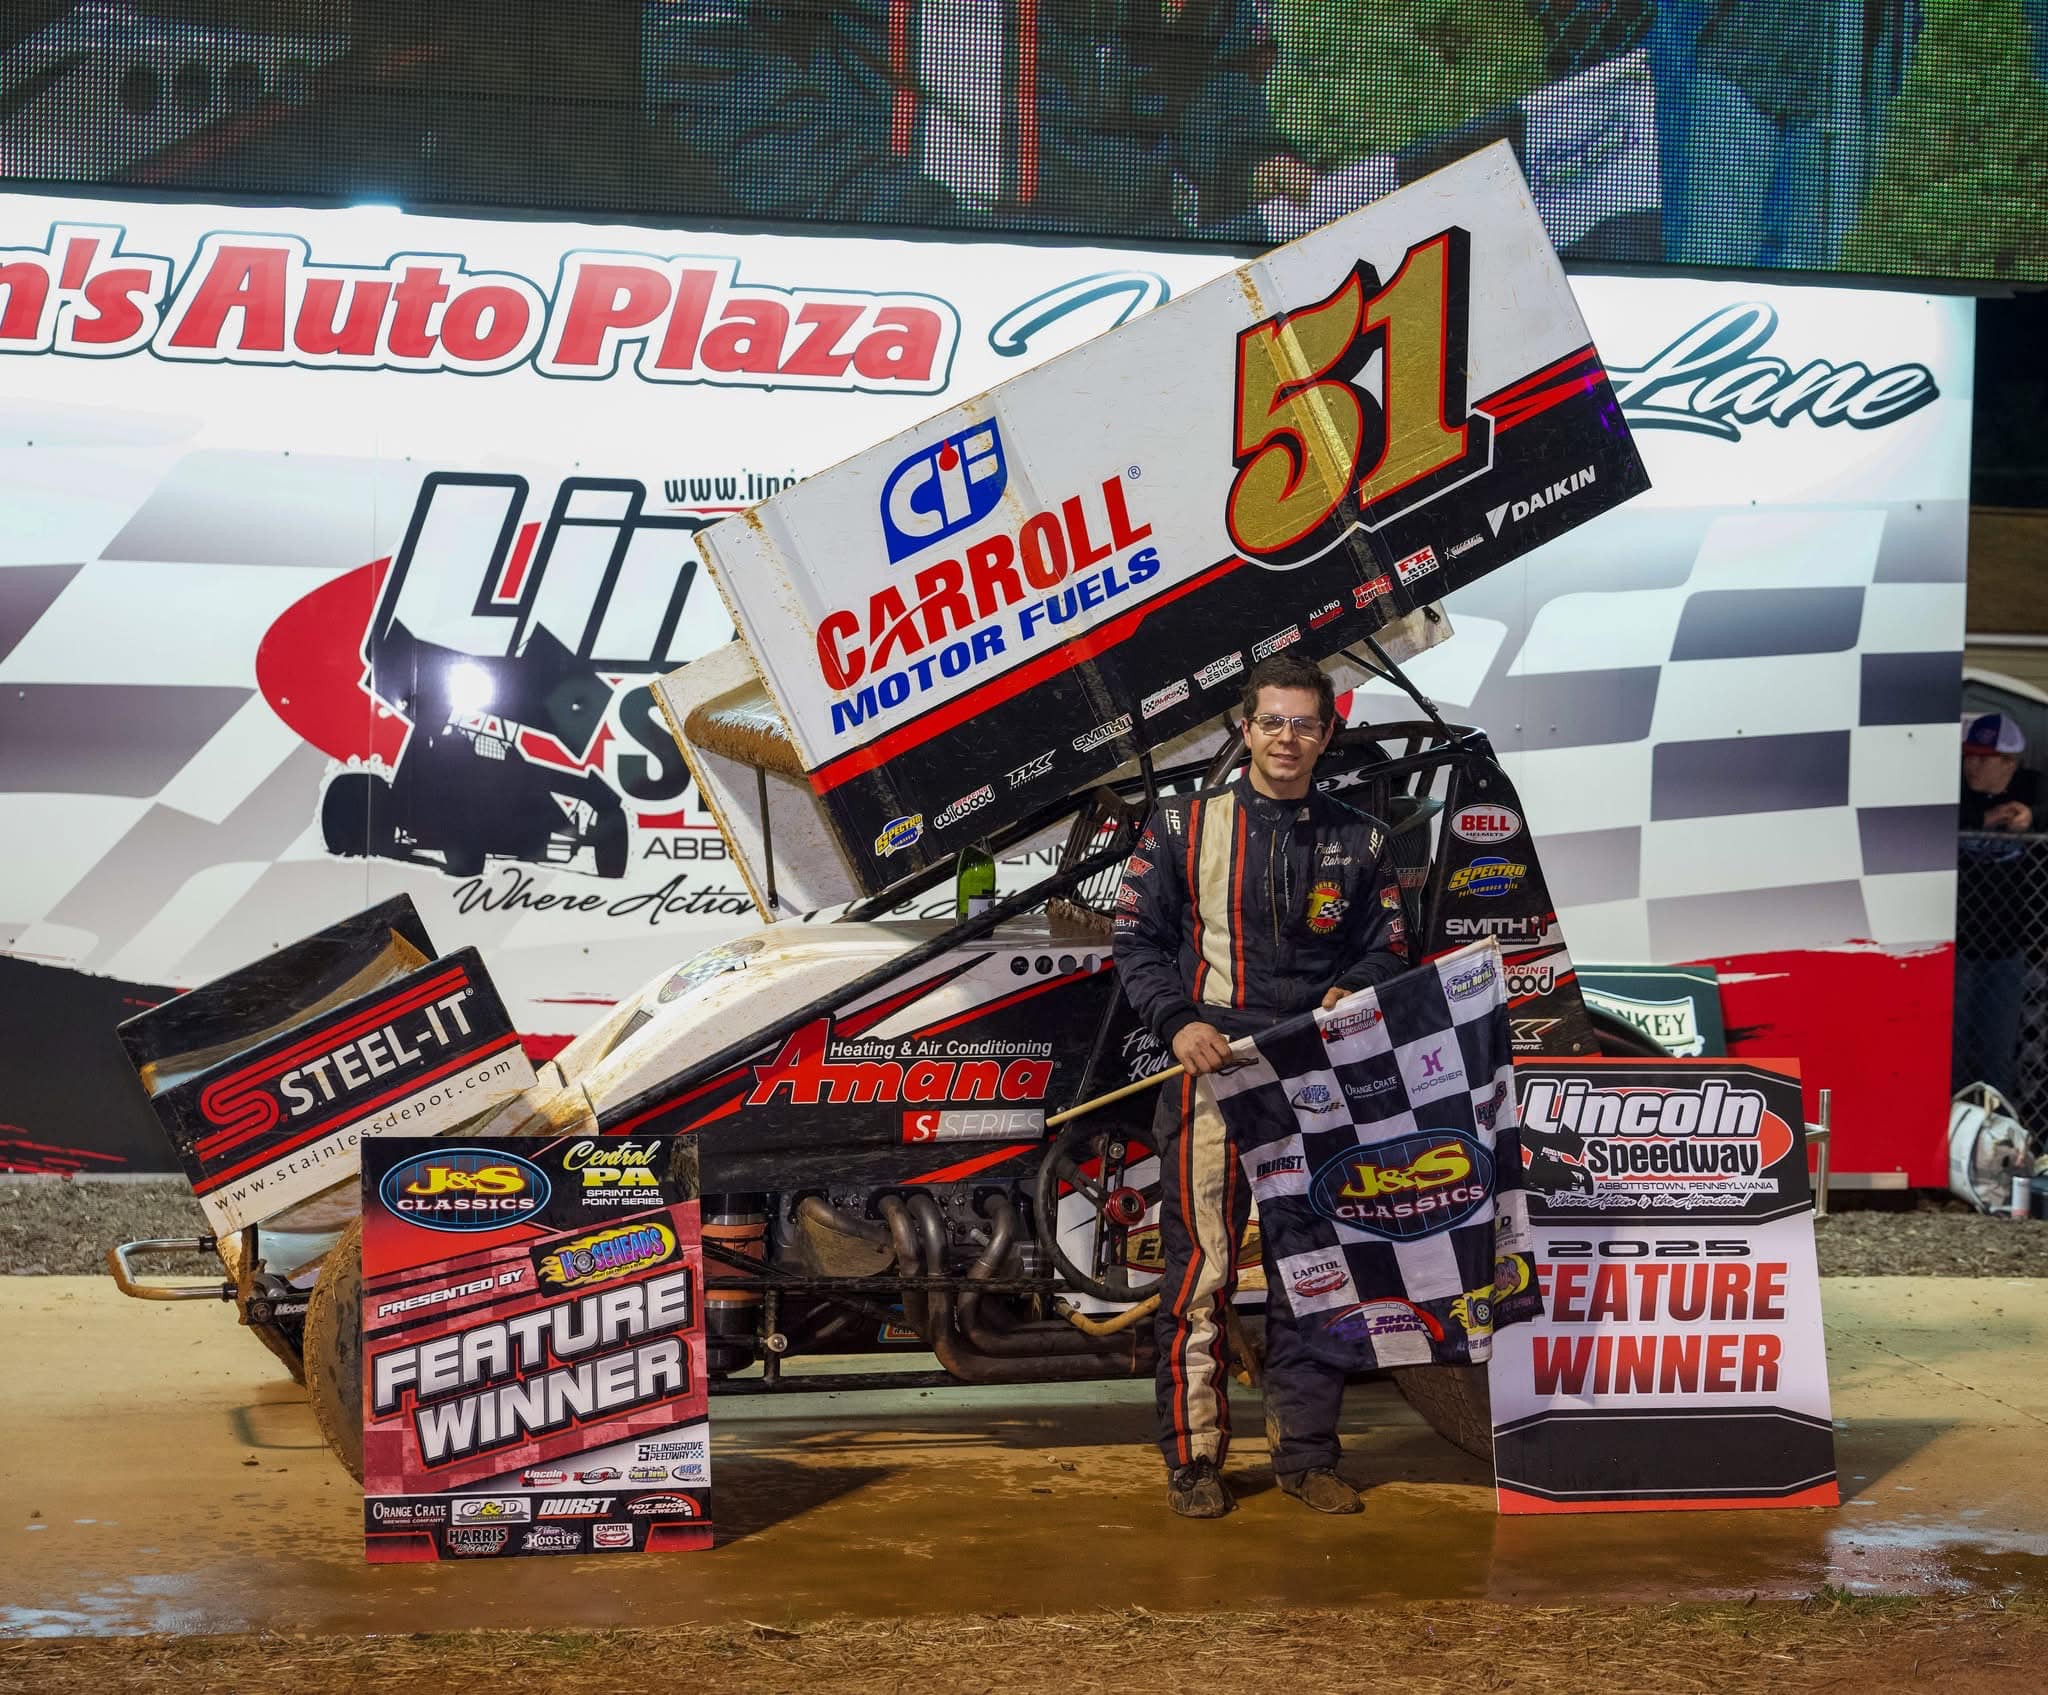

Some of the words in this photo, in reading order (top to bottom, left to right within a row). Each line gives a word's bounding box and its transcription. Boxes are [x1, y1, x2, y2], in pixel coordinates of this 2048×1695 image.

[168, 246, 530, 360] Auto
[552, 262, 942, 382] Plaza
[1604, 300, 1940, 442] Lane
[1226, 226, 1471, 560] 51
[1511, 465, 1596, 522] DAIKIN
[1398, 549, 1433, 573] FK
[1407, 558, 1436, 576] ROD
[816, 475, 1152, 692] CARROLL
[1402, 563, 1438, 585] ENDS
[1309, 609, 1324, 621] ALL
[1323, 600, 1340, 613] PRO
[831, 625, 1006, 735] MOTOR
[1018, 547, 1161, 642] FUELS
[1201, 660, 1242, 686] DESIGNS
[1204, 655, 1231, 675] CHOP
[935, 785, 995, 829] wilwood
[876, 815, 923, 855] SPECTRO
[1461, 815, 1510, 832] BELL
[1449, 865, 1528, 891] SPECTRO
[453, 868, 608, 914] Where
[1326, 1008, 1375, 1031] Lincoln
[279, 991, 473, 1116] STEEL-IT
[830, 1040, 896, 1058] Heating
[900, 1041, 913, 1055] &
[918, 1040, 942, 1055] Air
[946, 1038, 1053, 1058] Conditioning
[747, 1017, 1055, 1105] Amana
[1344, 1083, 1373, 1097] ORANGE
[1373, 1075, 1398, 1089] CRATE
[1411, 1069, 1463, 1094] HOOSIER
[1522, 1080, 1766, 1137] Lincoln
[215, 1060, 512, 1210] www.stainlessdepot.com
[912, 1111, 1041, 1142] S-SERIES
[563, 1140, 661, 1170] Central
[1588, 1140, 1758, 1177] Speedway
[406, 1167, 524, 1196] J&S
[582, 1168, 659, 1187] PA
[1340, 1143, 1471, 1198] J&S
[586, 1189, 632, 1198] SPRINT
[634, 1189, 659, 1197] CAR
[1598, 1182, 1686, 1192] ABBOTTSTOWN,
[1688, 1181, 1774, 1191] PENNSYLVANIA
[397, 1199, 536, 1211] CLASSICS
[582, 1198, 616, 1206] POINT
[618, 1197, 664, 1206] SERIES
[1336, 1185, 1486, 1218] CLASSICS
[1652, 1193, 1676, 1207] the
[1548, 1240, 1751, 1257] 2025
[1293, 1260, 1342, 1280] CAPITOL
[378, 1278, 495, 1318] PRESENTED
[499, 1268, 527, 1288] BY
[375, 1273, 688, 1409] FEATURE
[1533, 1334, 1783, 1395] WINNER
[417, 1338, 682, 1460] WINNER
[525, 1470, 563, 1479] Lincoln
[373, 1502, 412, 1520] ORANGE
[415, 1503, 447, 1517] CRATE
[461, 1500, 522, 1517] C&D
[539, 1498, 616, 1515] DURST
[627, 1502, 654, 1510] HOT
[633, 1507, 686, 1515] RACEWEAR
[449, 1528, 507, 1544] HARRIS
[526, 1533, 579, 1549] Hoosier
